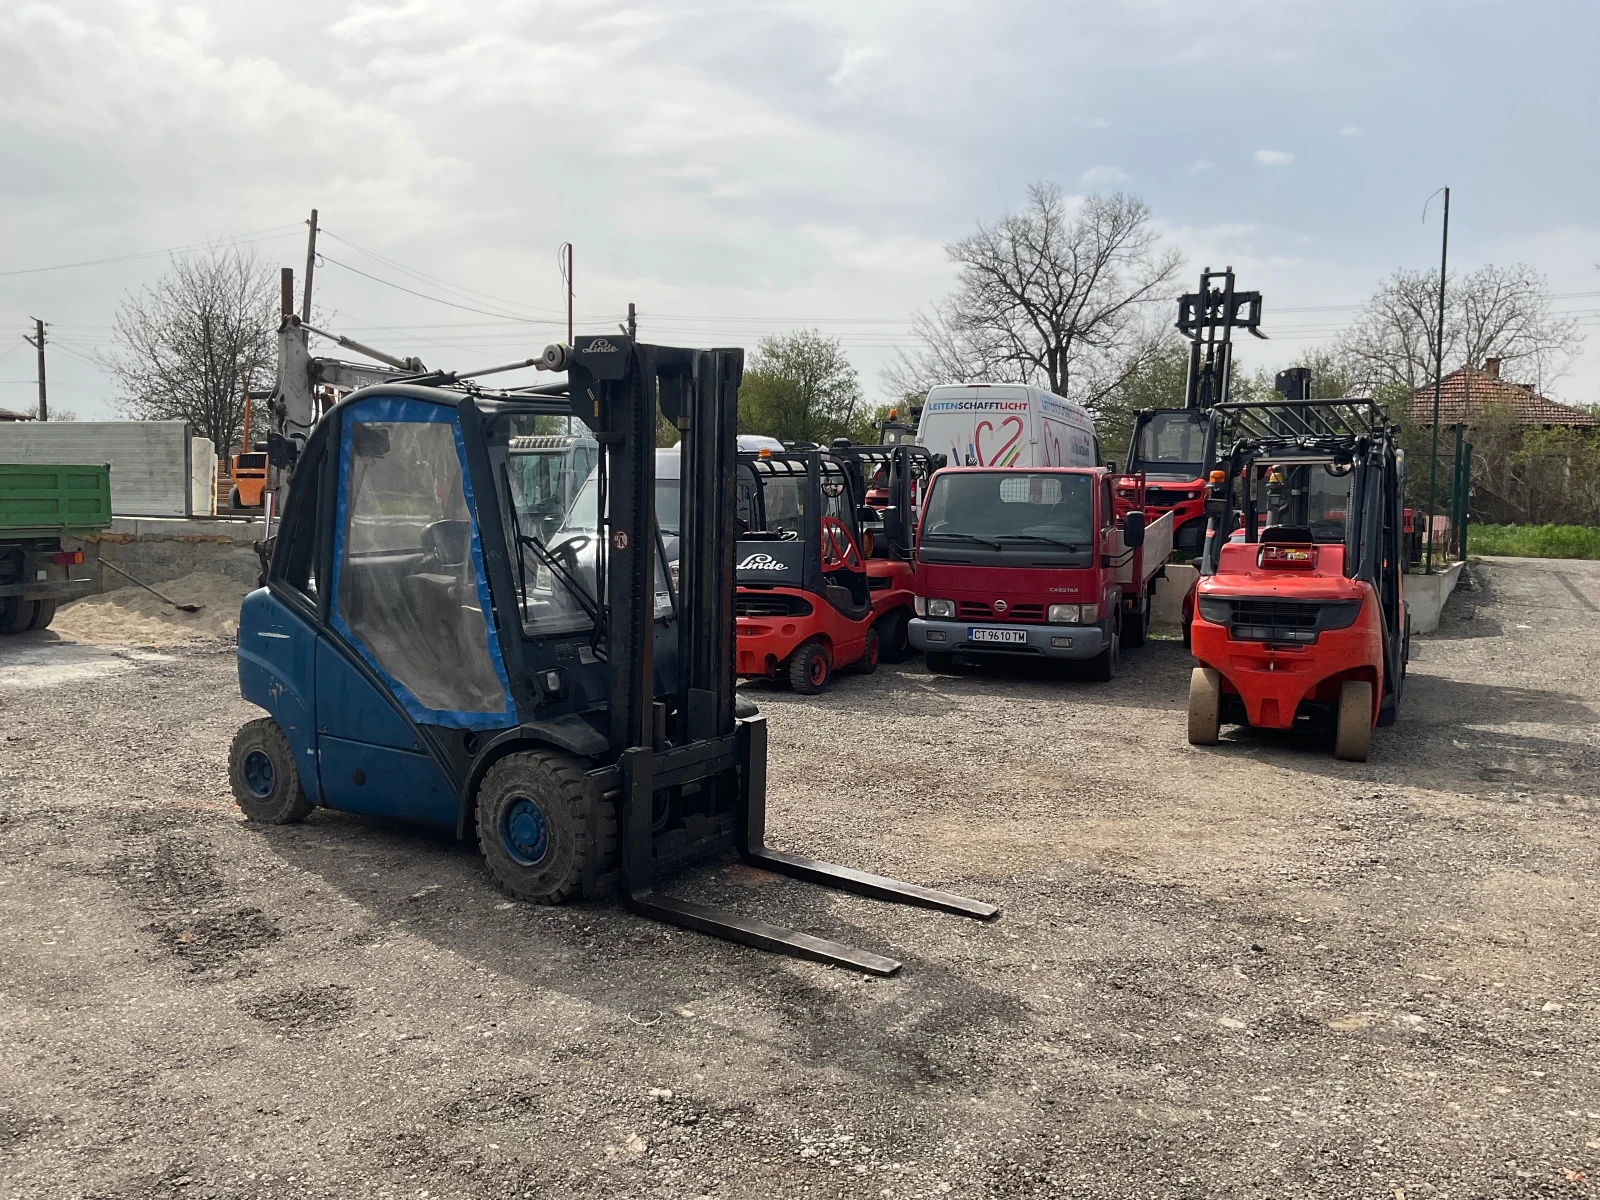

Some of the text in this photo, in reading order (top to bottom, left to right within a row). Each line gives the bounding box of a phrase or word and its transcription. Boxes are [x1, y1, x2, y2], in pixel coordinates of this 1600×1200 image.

[582, 338, 619, 354] Linde
[928, 402, 1028, 410] LEITENSCHAFFTLICHT
[736, 553, 788, 570] Linde
[974, 630, 986, 640] CT
[988, 631, 1010, 640] 9610
[1012, 632, 1024, 641] TM
